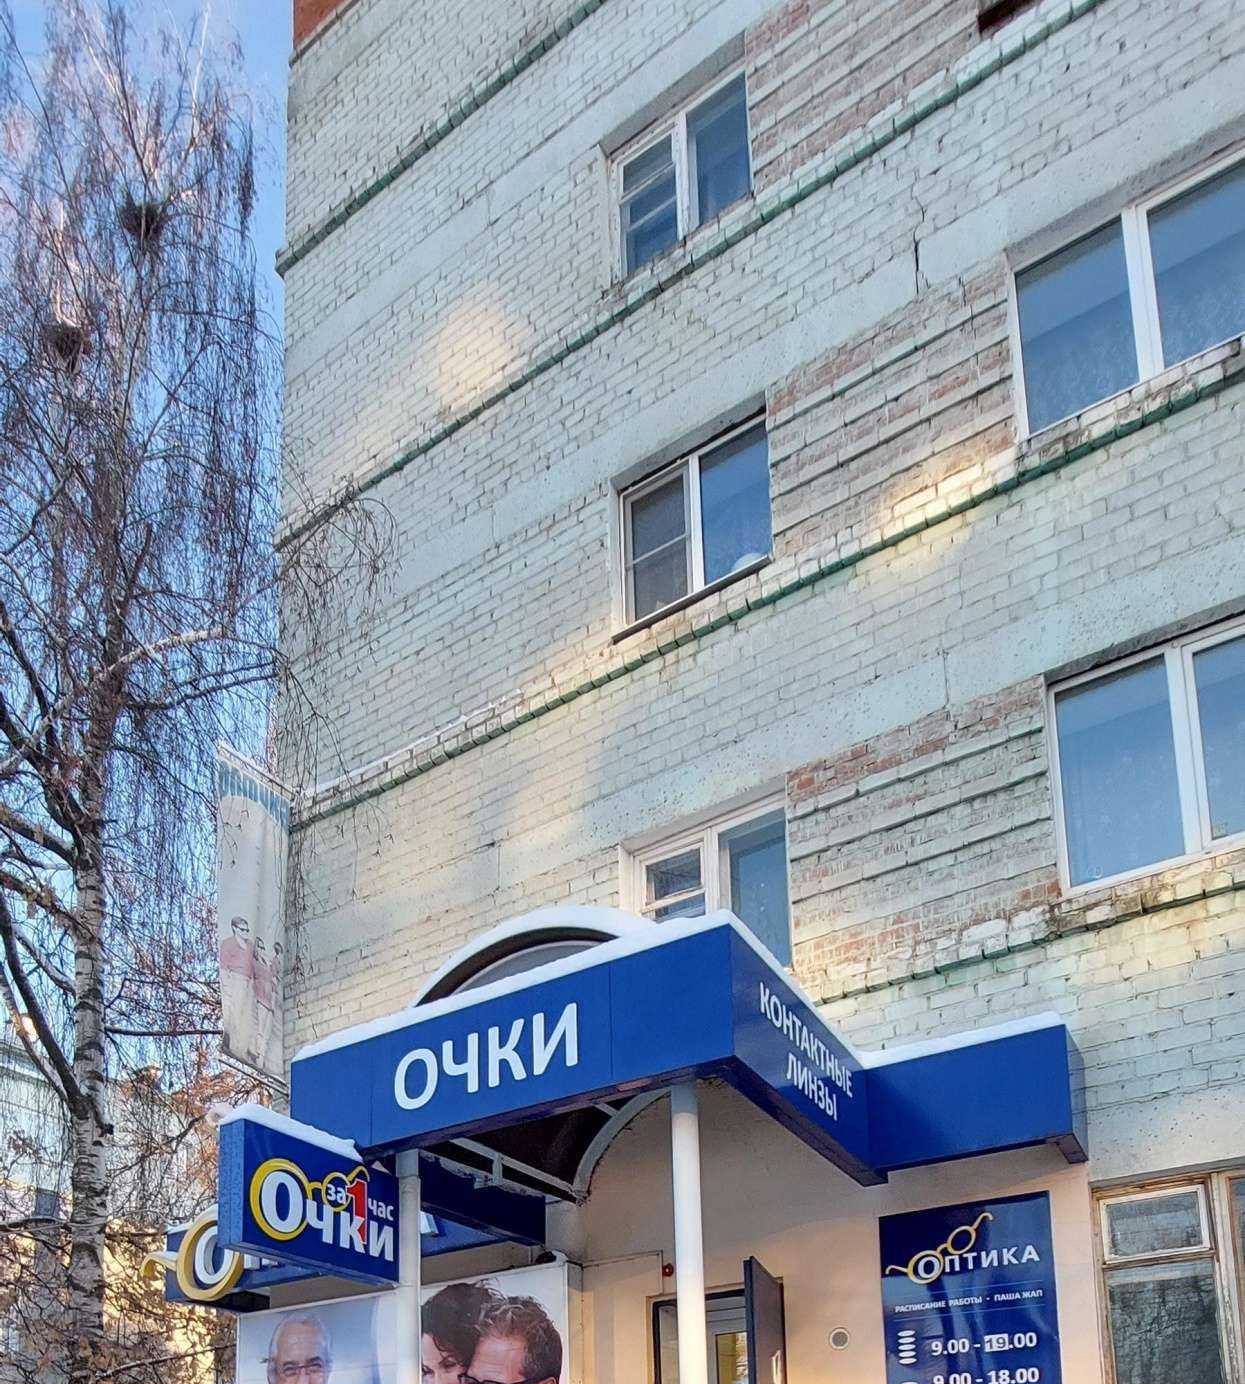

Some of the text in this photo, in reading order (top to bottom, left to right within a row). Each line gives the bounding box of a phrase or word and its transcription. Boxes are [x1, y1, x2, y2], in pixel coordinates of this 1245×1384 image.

[394, 1003, 579, 1111] ОЧКИ
[759, 982, 853, 1098] КОНТАКТНЫЕ
[786, 1052, 838, 1121] ЛИНЗЫ
[327, 1184, 346, 1204] за
[368, 1198, 394, 1222] час
[895, 1300, 946, 1313] РАСПИСАНИЕ
[948, 1296, 983, 1307] РАБОТЫ
[994, 1292, 1021, 1302] ПАША
[931, 1338, 970, 1356] 9.00
[984, 1332, 1038, 1352] 19.00
